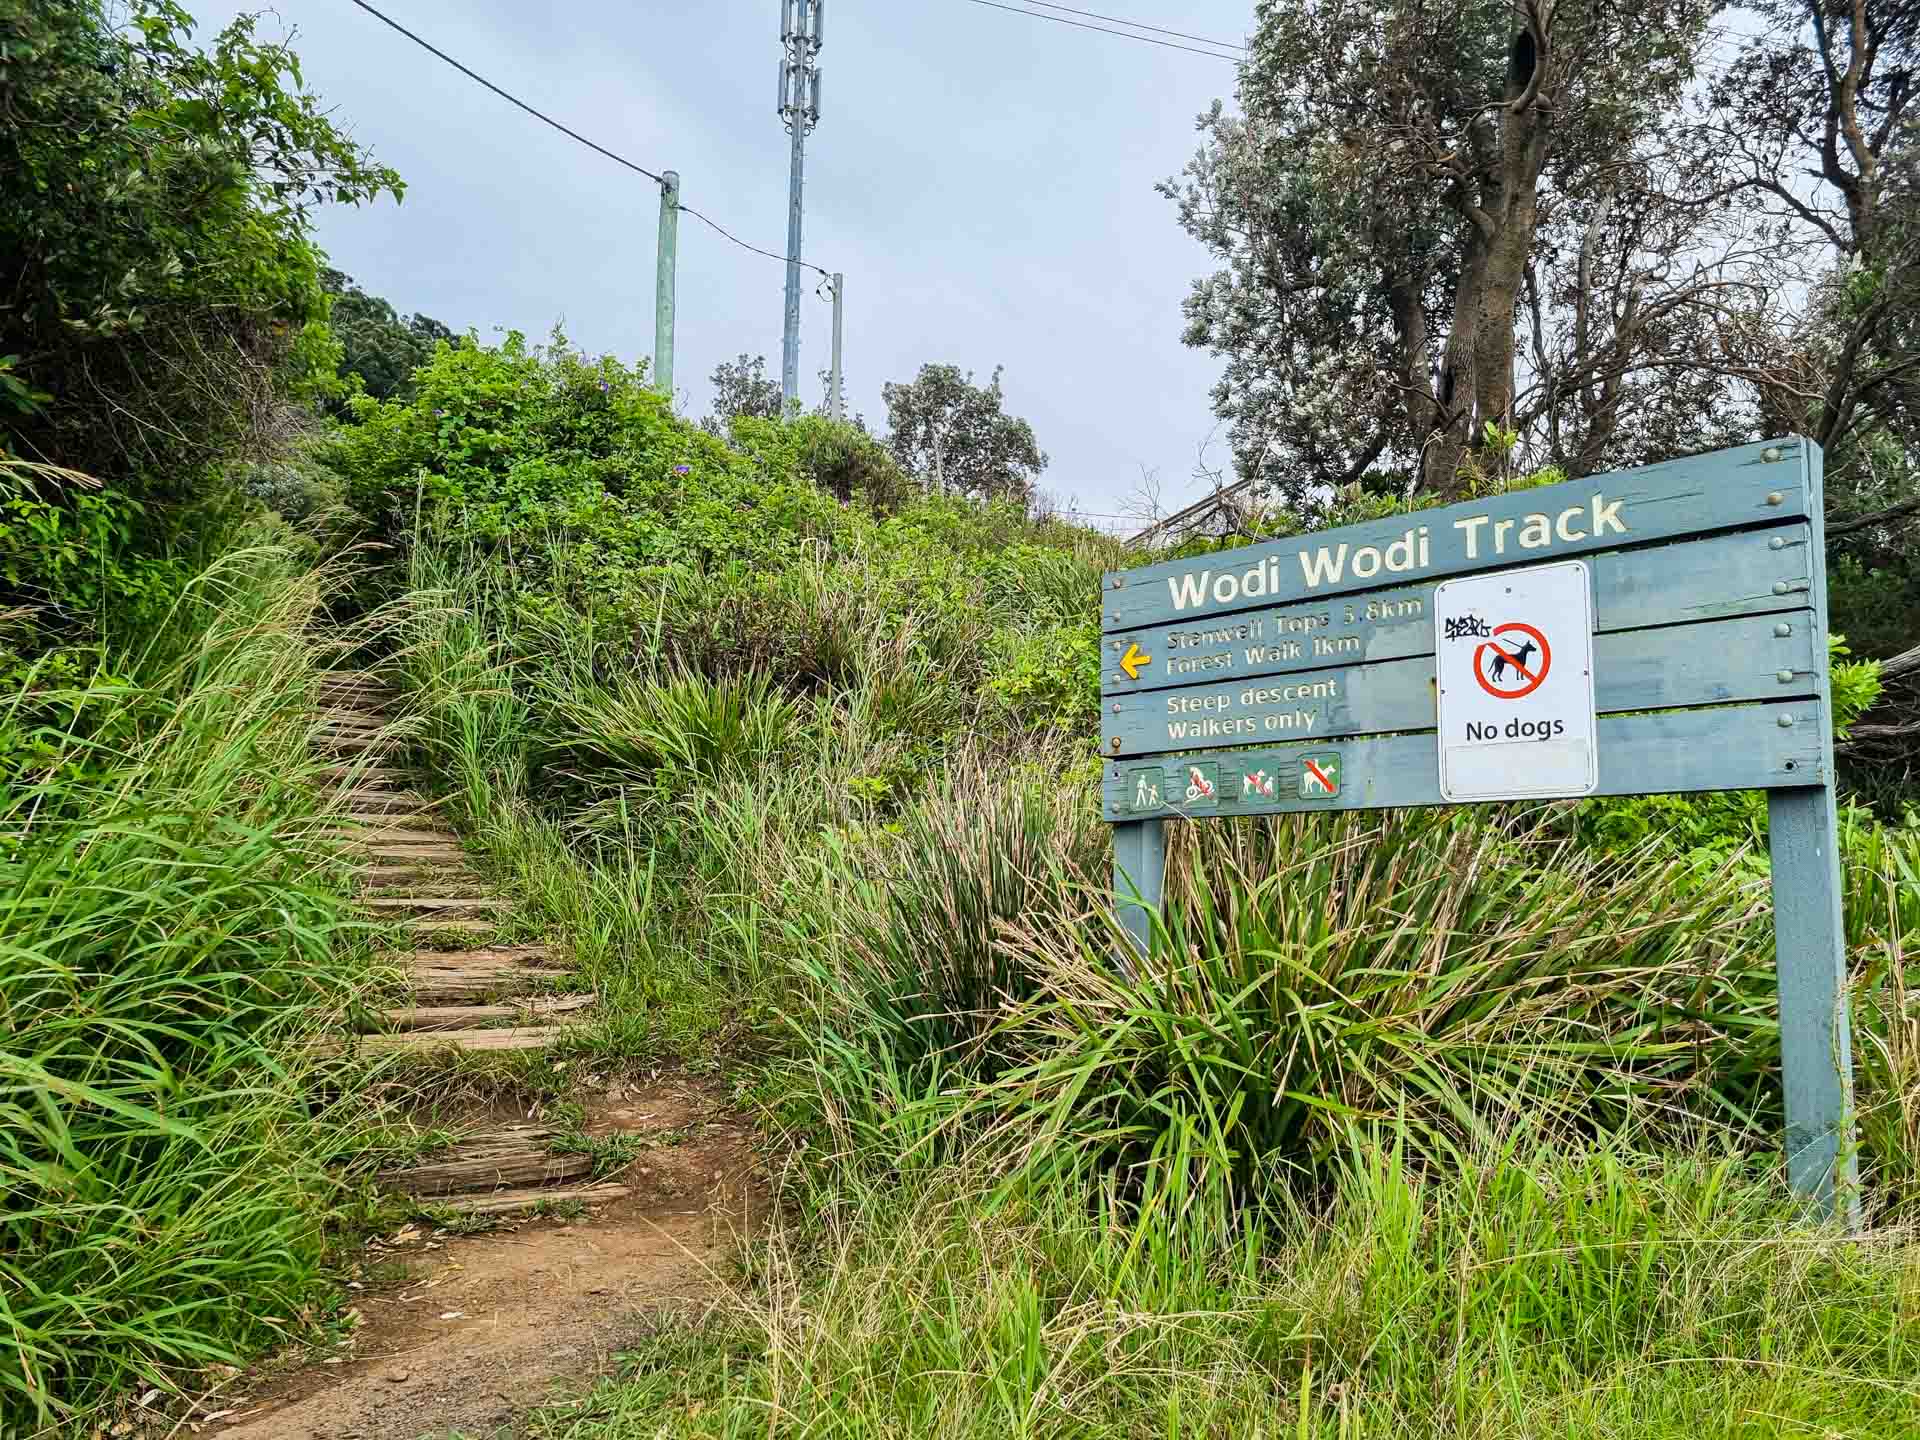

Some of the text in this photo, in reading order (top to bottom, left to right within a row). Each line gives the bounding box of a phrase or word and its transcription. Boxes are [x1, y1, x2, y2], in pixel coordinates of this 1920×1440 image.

[1167, 493, 1629, 610] Wodi Wodi Track
[1167, 618, 1264, 649] Stanwell
[1276, 611, 1329, 637] Tops
[1167, 634, 1361, 675] Forest Walk 1km
[1167, 679, 1337, 715] Steep descent
[1167, 707, 1319, 740] Walkers only
[1466, 718, 1564, 741] No dogs
